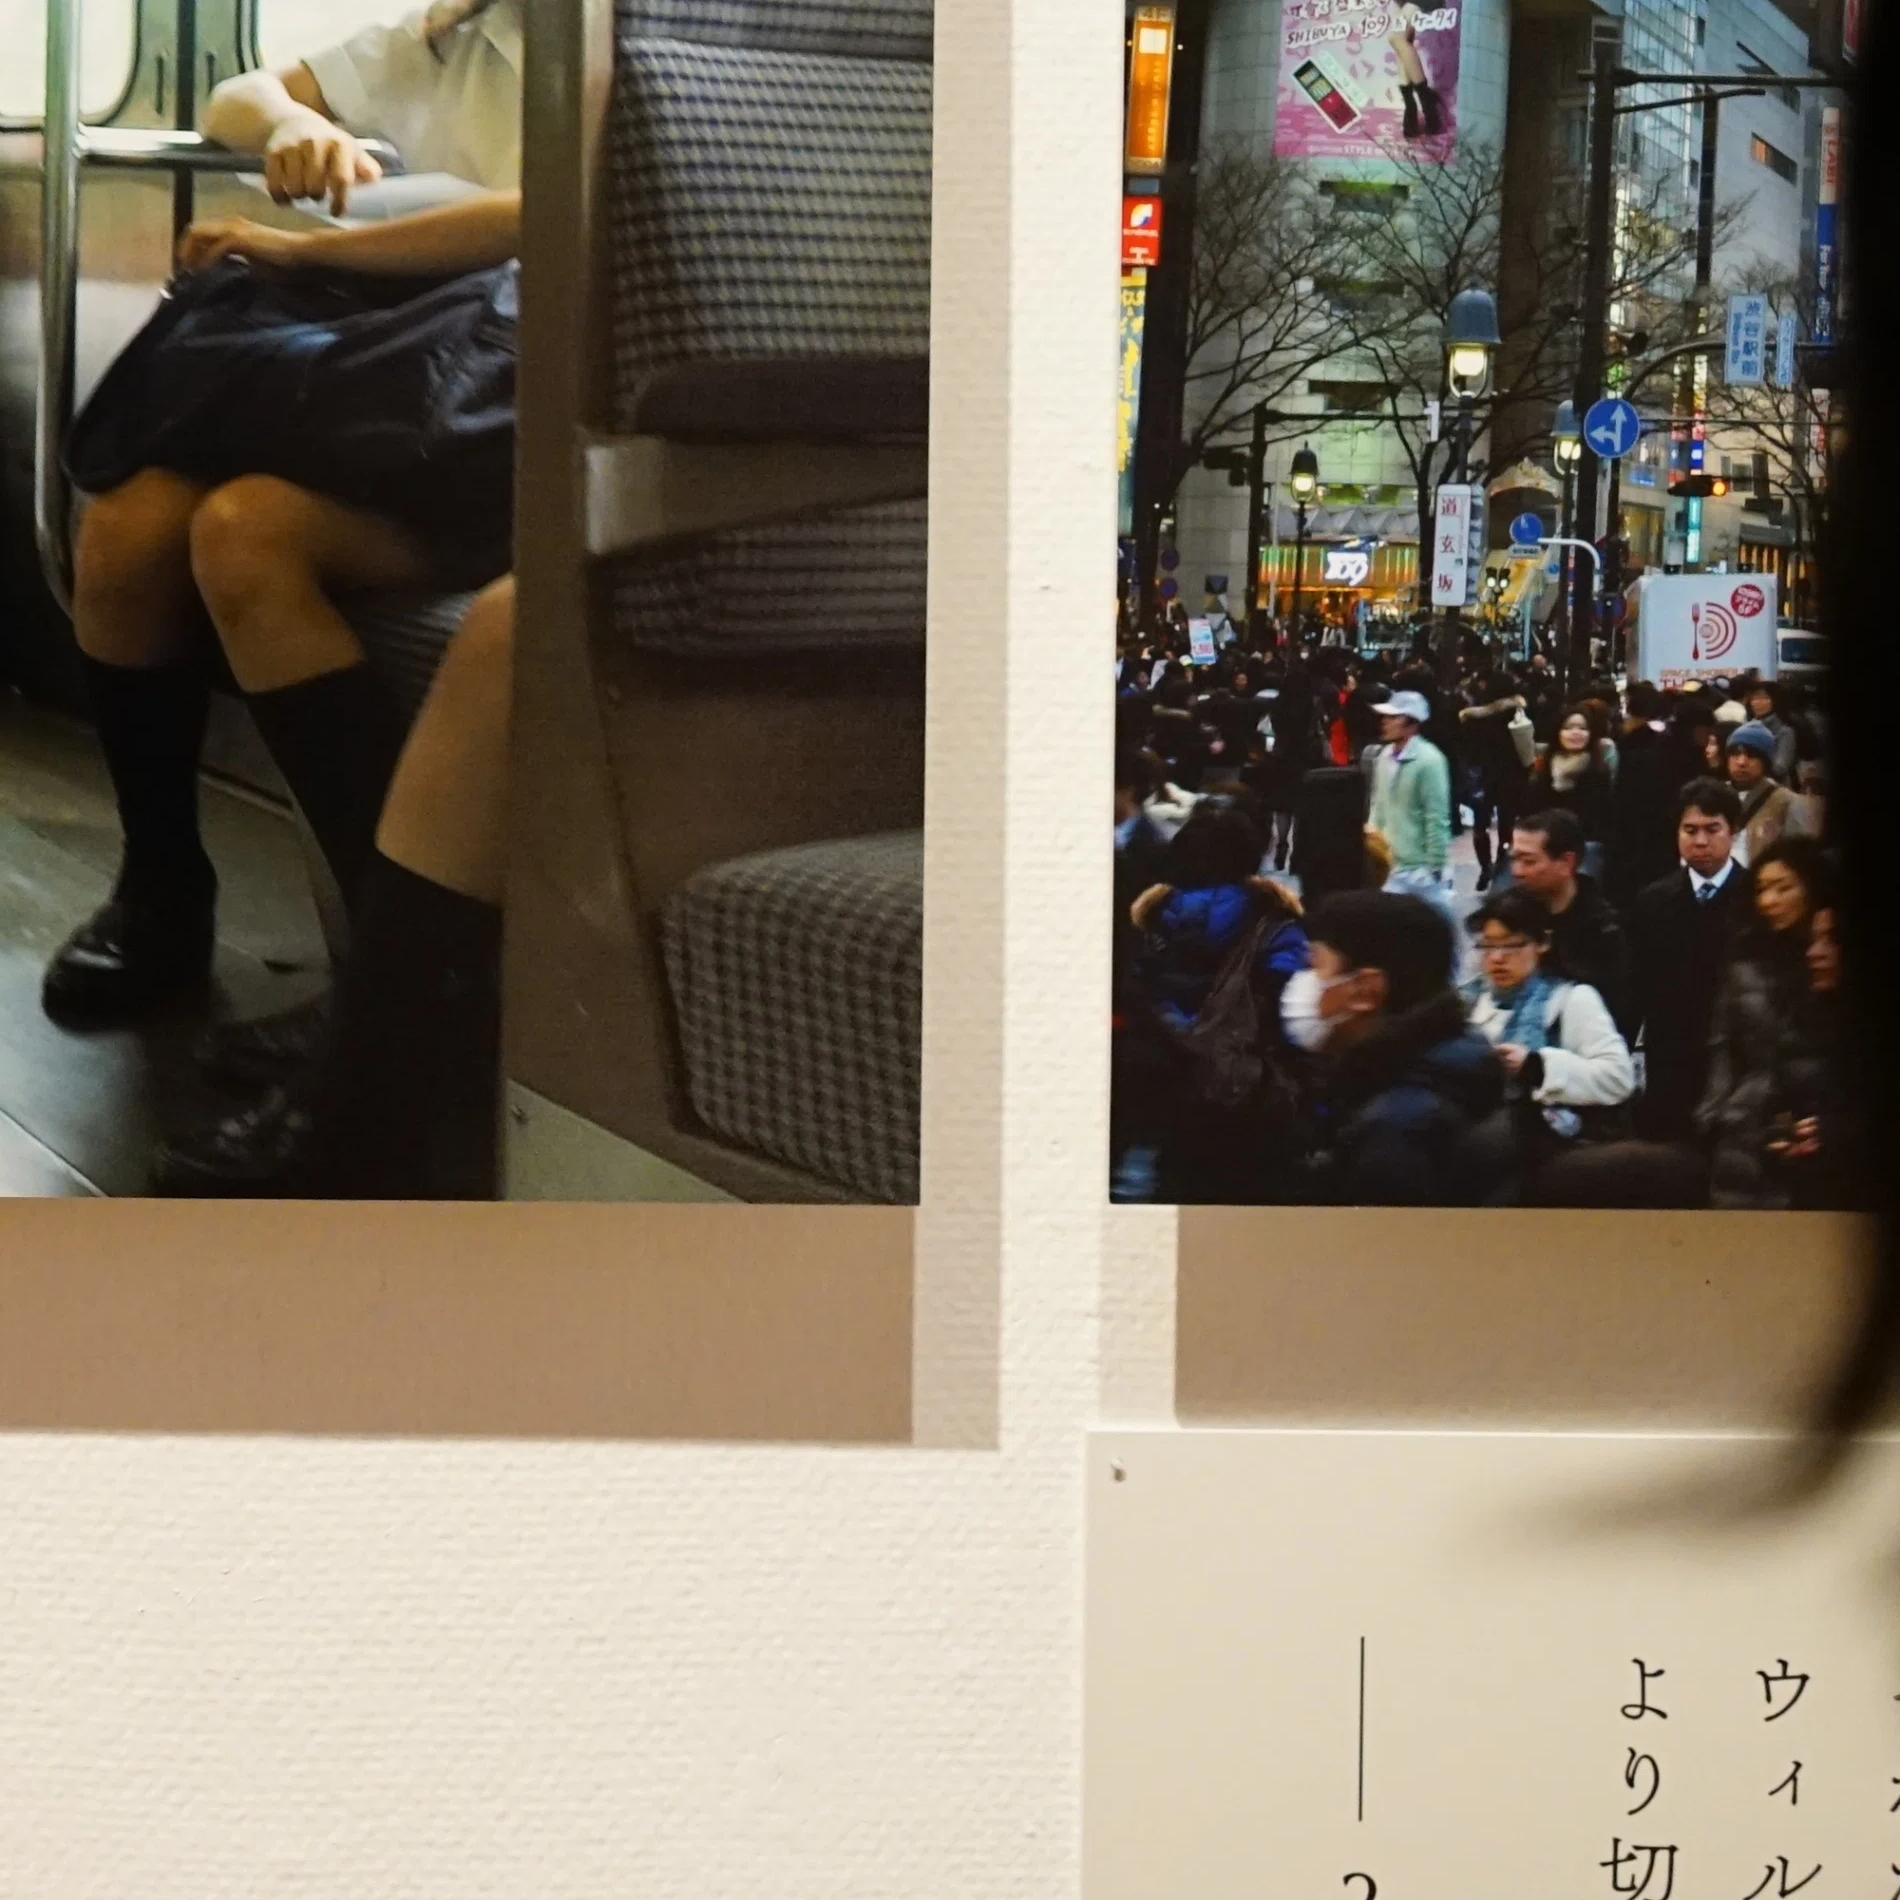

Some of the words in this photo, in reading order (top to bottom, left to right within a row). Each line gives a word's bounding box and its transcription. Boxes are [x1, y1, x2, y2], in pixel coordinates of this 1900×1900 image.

[1437, 496, 1457, 593] 道玄坂
[1600, 1657, 1679, 1900] より切
[1743, 1657, 1822, 1900] ウィル
